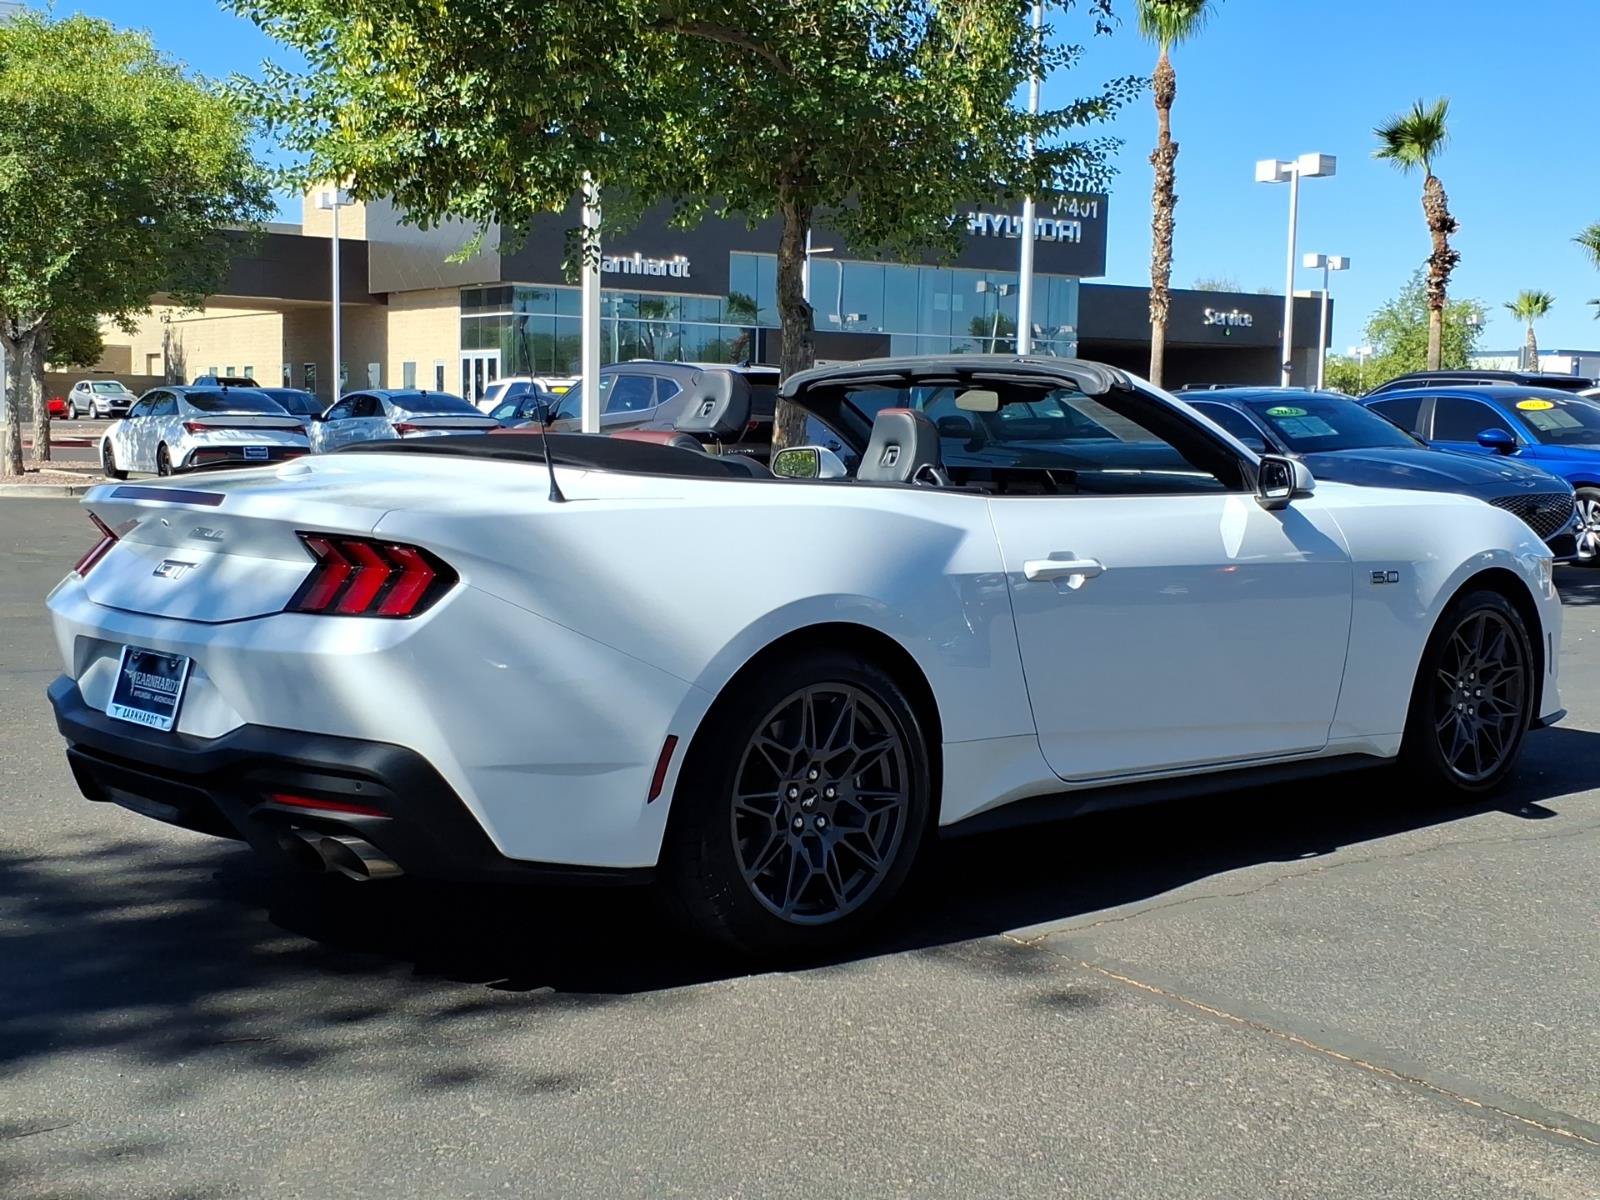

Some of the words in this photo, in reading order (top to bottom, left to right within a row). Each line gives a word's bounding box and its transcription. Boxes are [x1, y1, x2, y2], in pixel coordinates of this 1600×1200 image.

[600, 252, 691, 278] arnhardt
[1204, 308, 1253, 327] Service
[153, 559, 201, 580] GT
